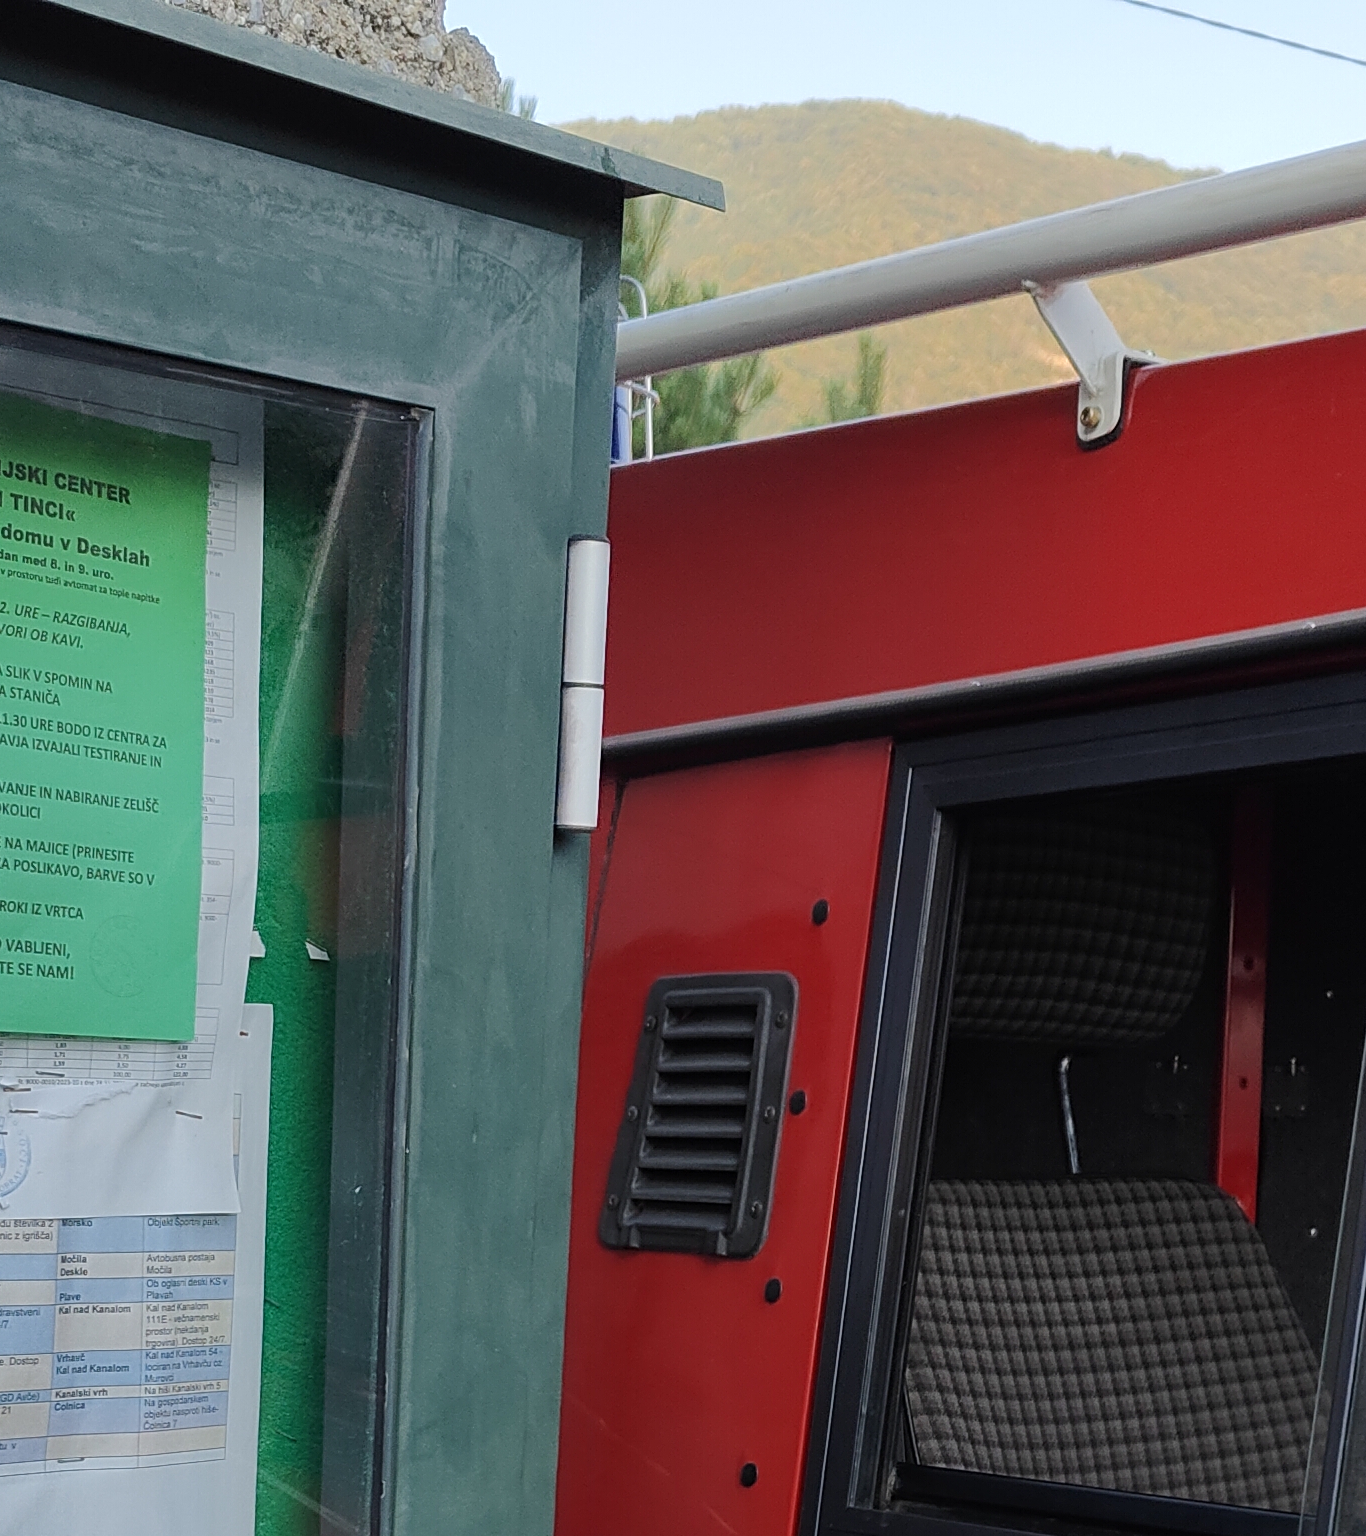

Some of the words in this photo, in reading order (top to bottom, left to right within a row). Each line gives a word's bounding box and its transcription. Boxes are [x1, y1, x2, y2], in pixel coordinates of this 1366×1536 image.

[55, 472, 130, 505] CENTER
[1, 523, 53, 548] domu
[60, 538, 70, 551] v
[78, 537, 149, 567] Desklah
[6, 939, 70, 960] VABLJENI,
[18, 962, 33, 976] SE
[37, 963, 73, 980] NAM!
[60, 1267, 88, 1278] Deskle
